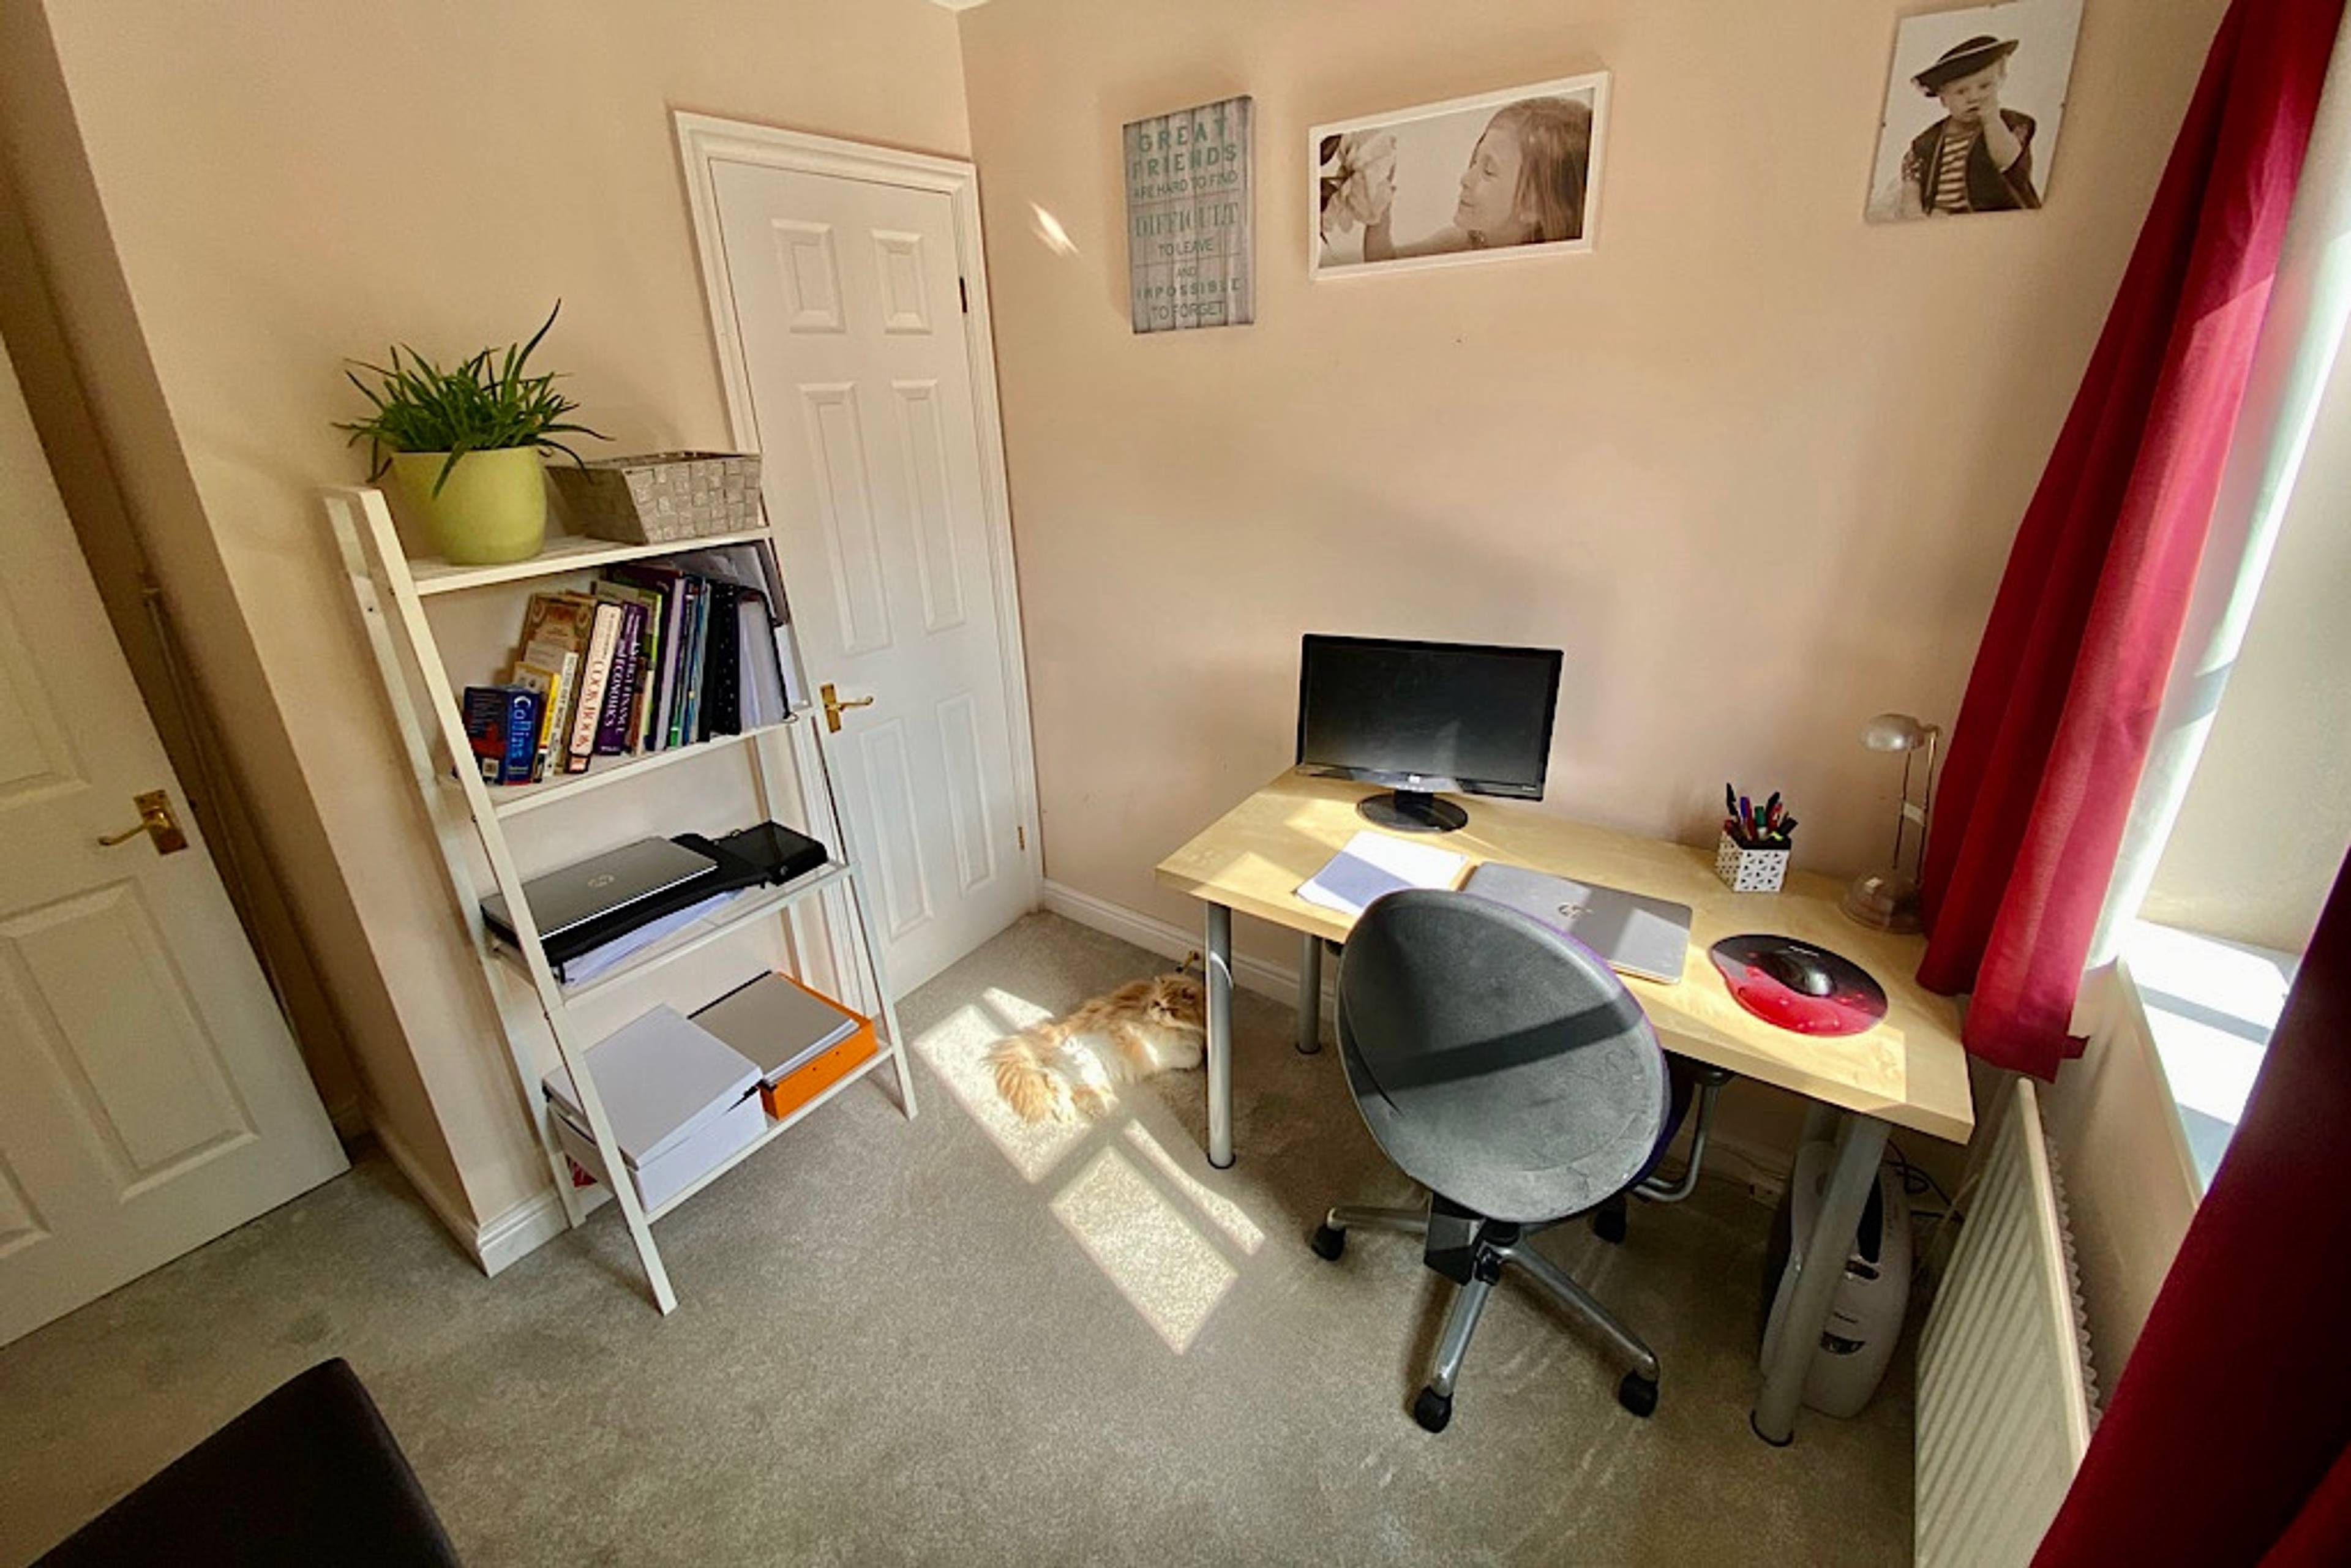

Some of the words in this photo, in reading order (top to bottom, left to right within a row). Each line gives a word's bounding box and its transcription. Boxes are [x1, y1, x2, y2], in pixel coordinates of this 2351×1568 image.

[1139, 116, 1228, 153] GREAT
[1133, 143, 1237, 180] FRIENDS
[1134, 185, 1155, 200] ARE
[1157, 178, 1188, 196] HARD
[1191, 176, 1207, 190] TO
[1210, 169, 1239, 187] FIND
[1136, 203, 1239, 237] DIFFICULT
[1158, 243, 1174, 257] TO
[1176, 238, 1214, 255] LEAVE
[1177, 266, 1196, 276] AND
[1137, 277, 1240, 300] IMPOSSIBLE
[1151, 306, 1170, 320] TO
[1171, 300, 1226, 318] FORGET
[604, 658, 626, 727] ECONOMICS
[511, 695, 532, 759] Collins
